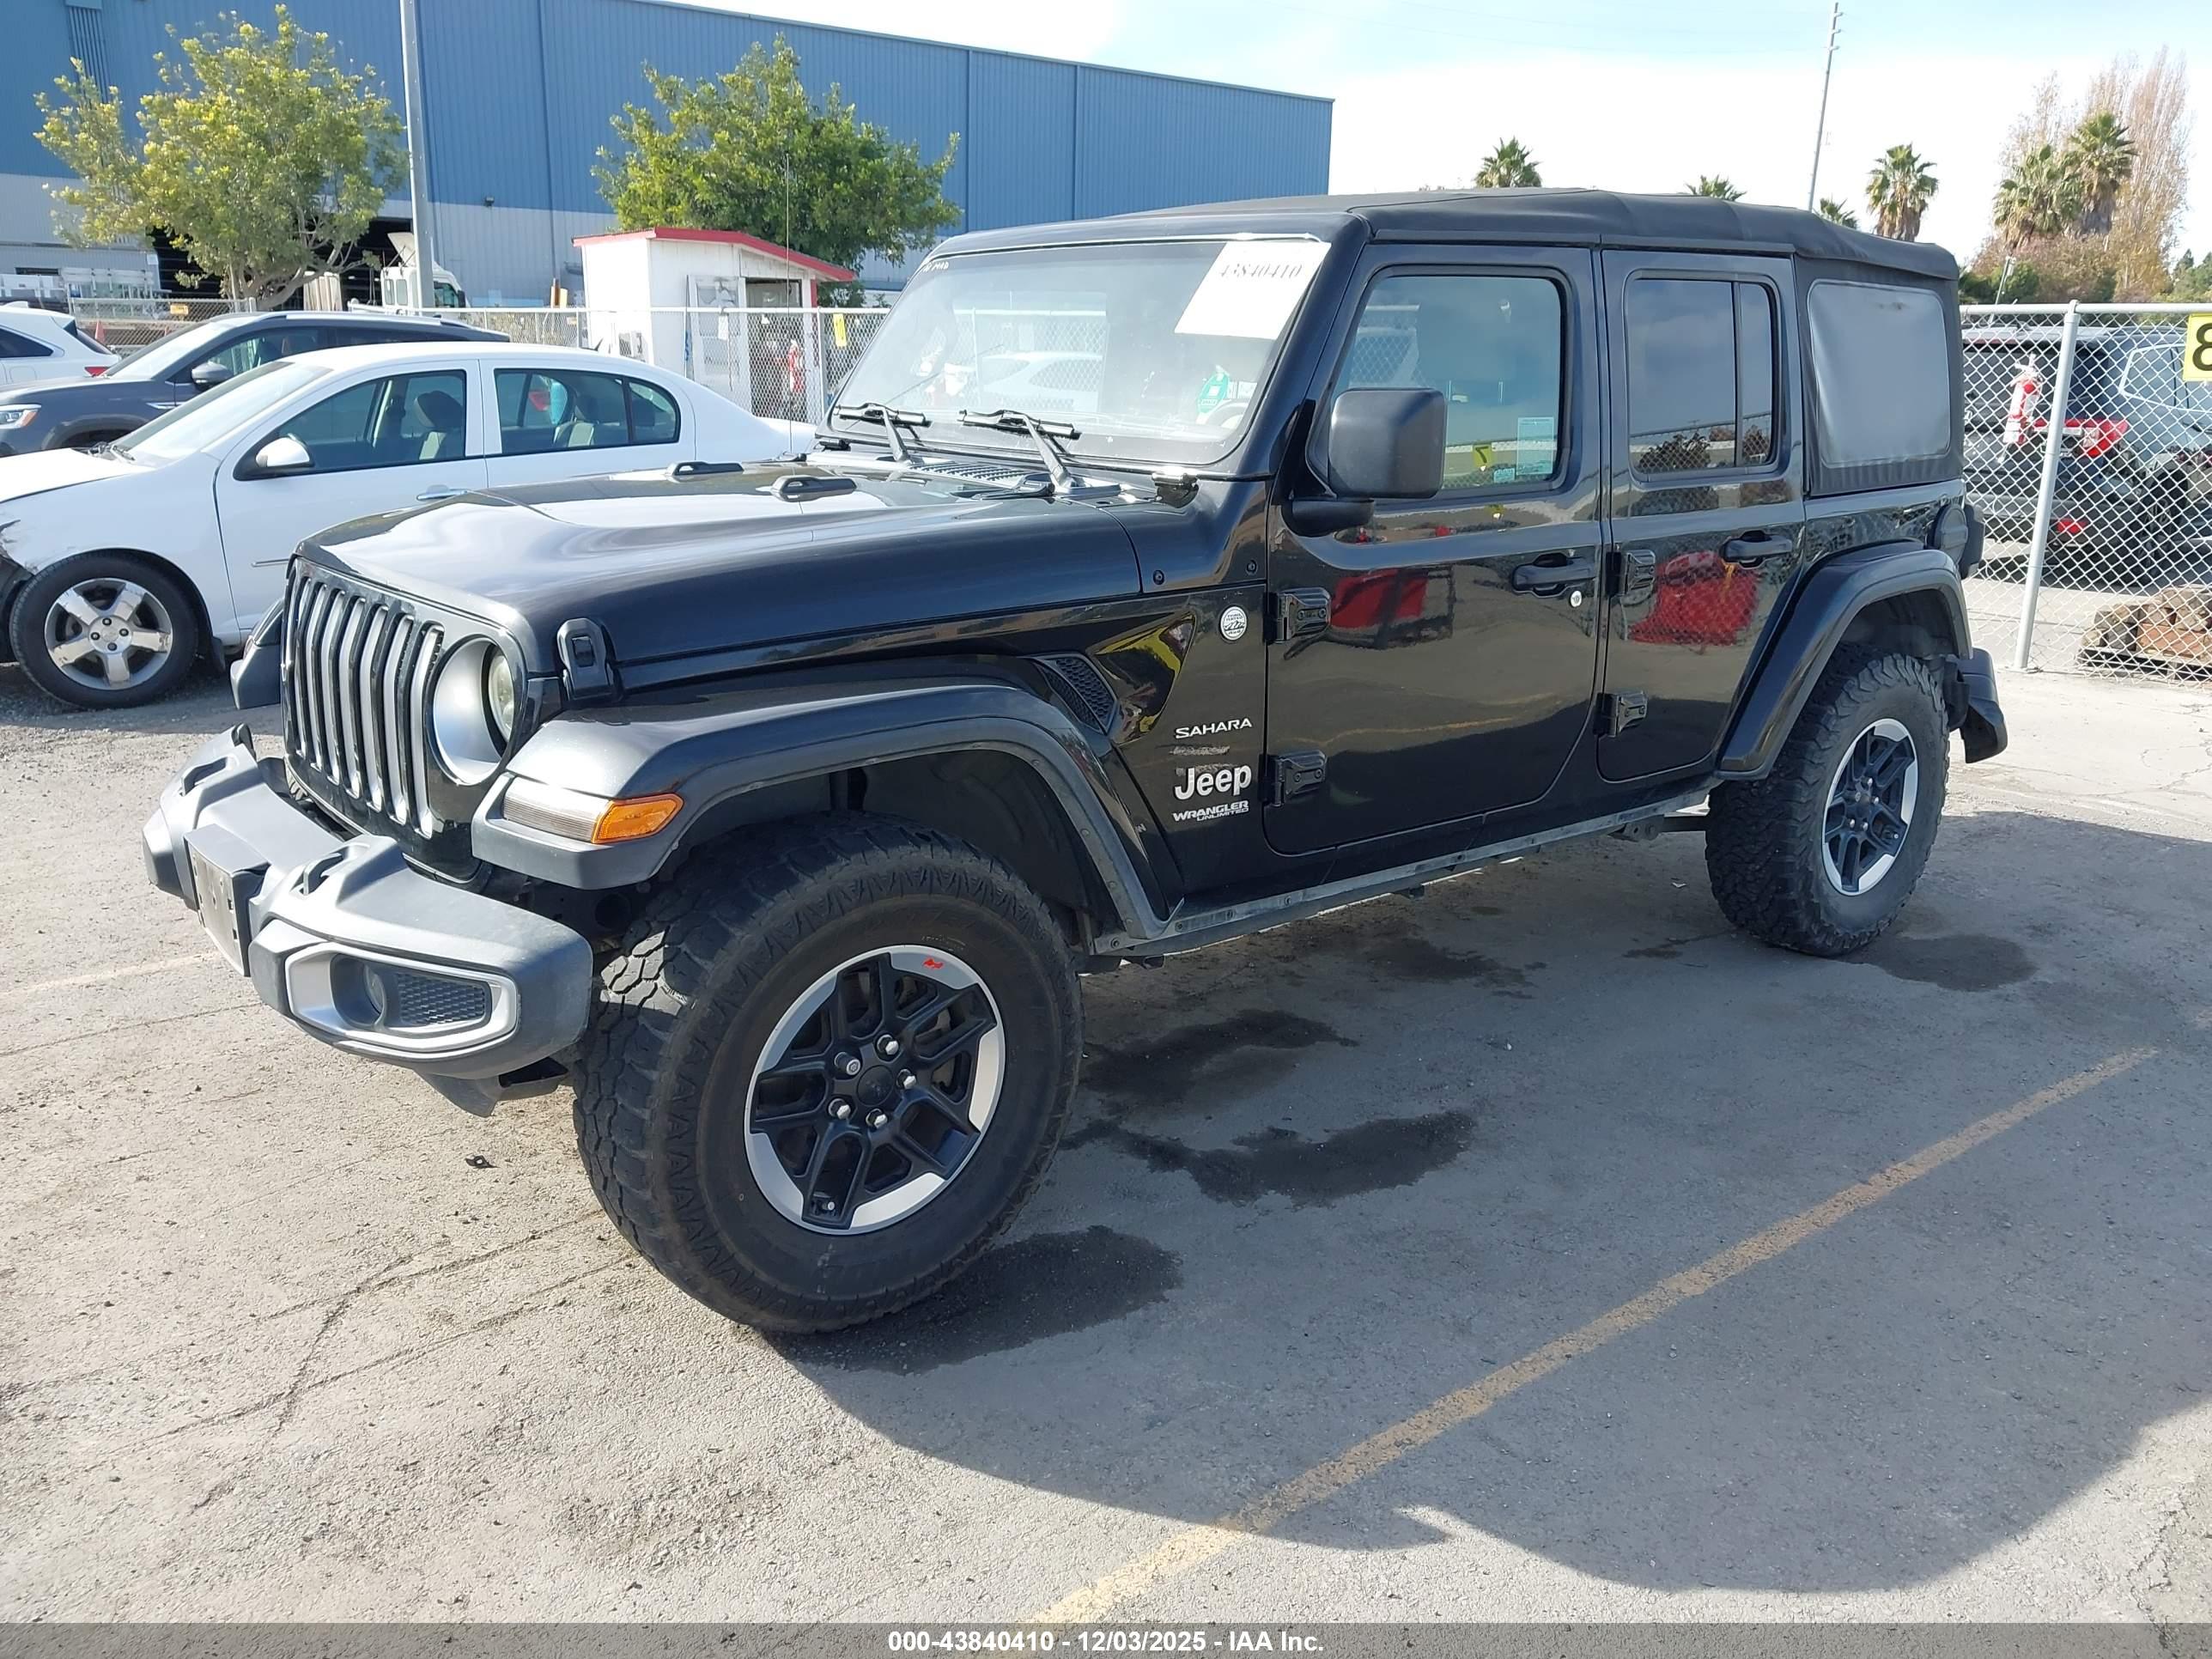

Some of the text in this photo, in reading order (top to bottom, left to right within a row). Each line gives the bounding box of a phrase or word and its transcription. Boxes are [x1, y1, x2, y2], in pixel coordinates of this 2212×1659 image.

[1175, 718, 1252, 739] SAHARA
[1173, 765, 1252, 800] Jeep
[1173, 800, 1249, 822] WRANGLER
[1196, 808, 1249, 822] UNLIMITED
